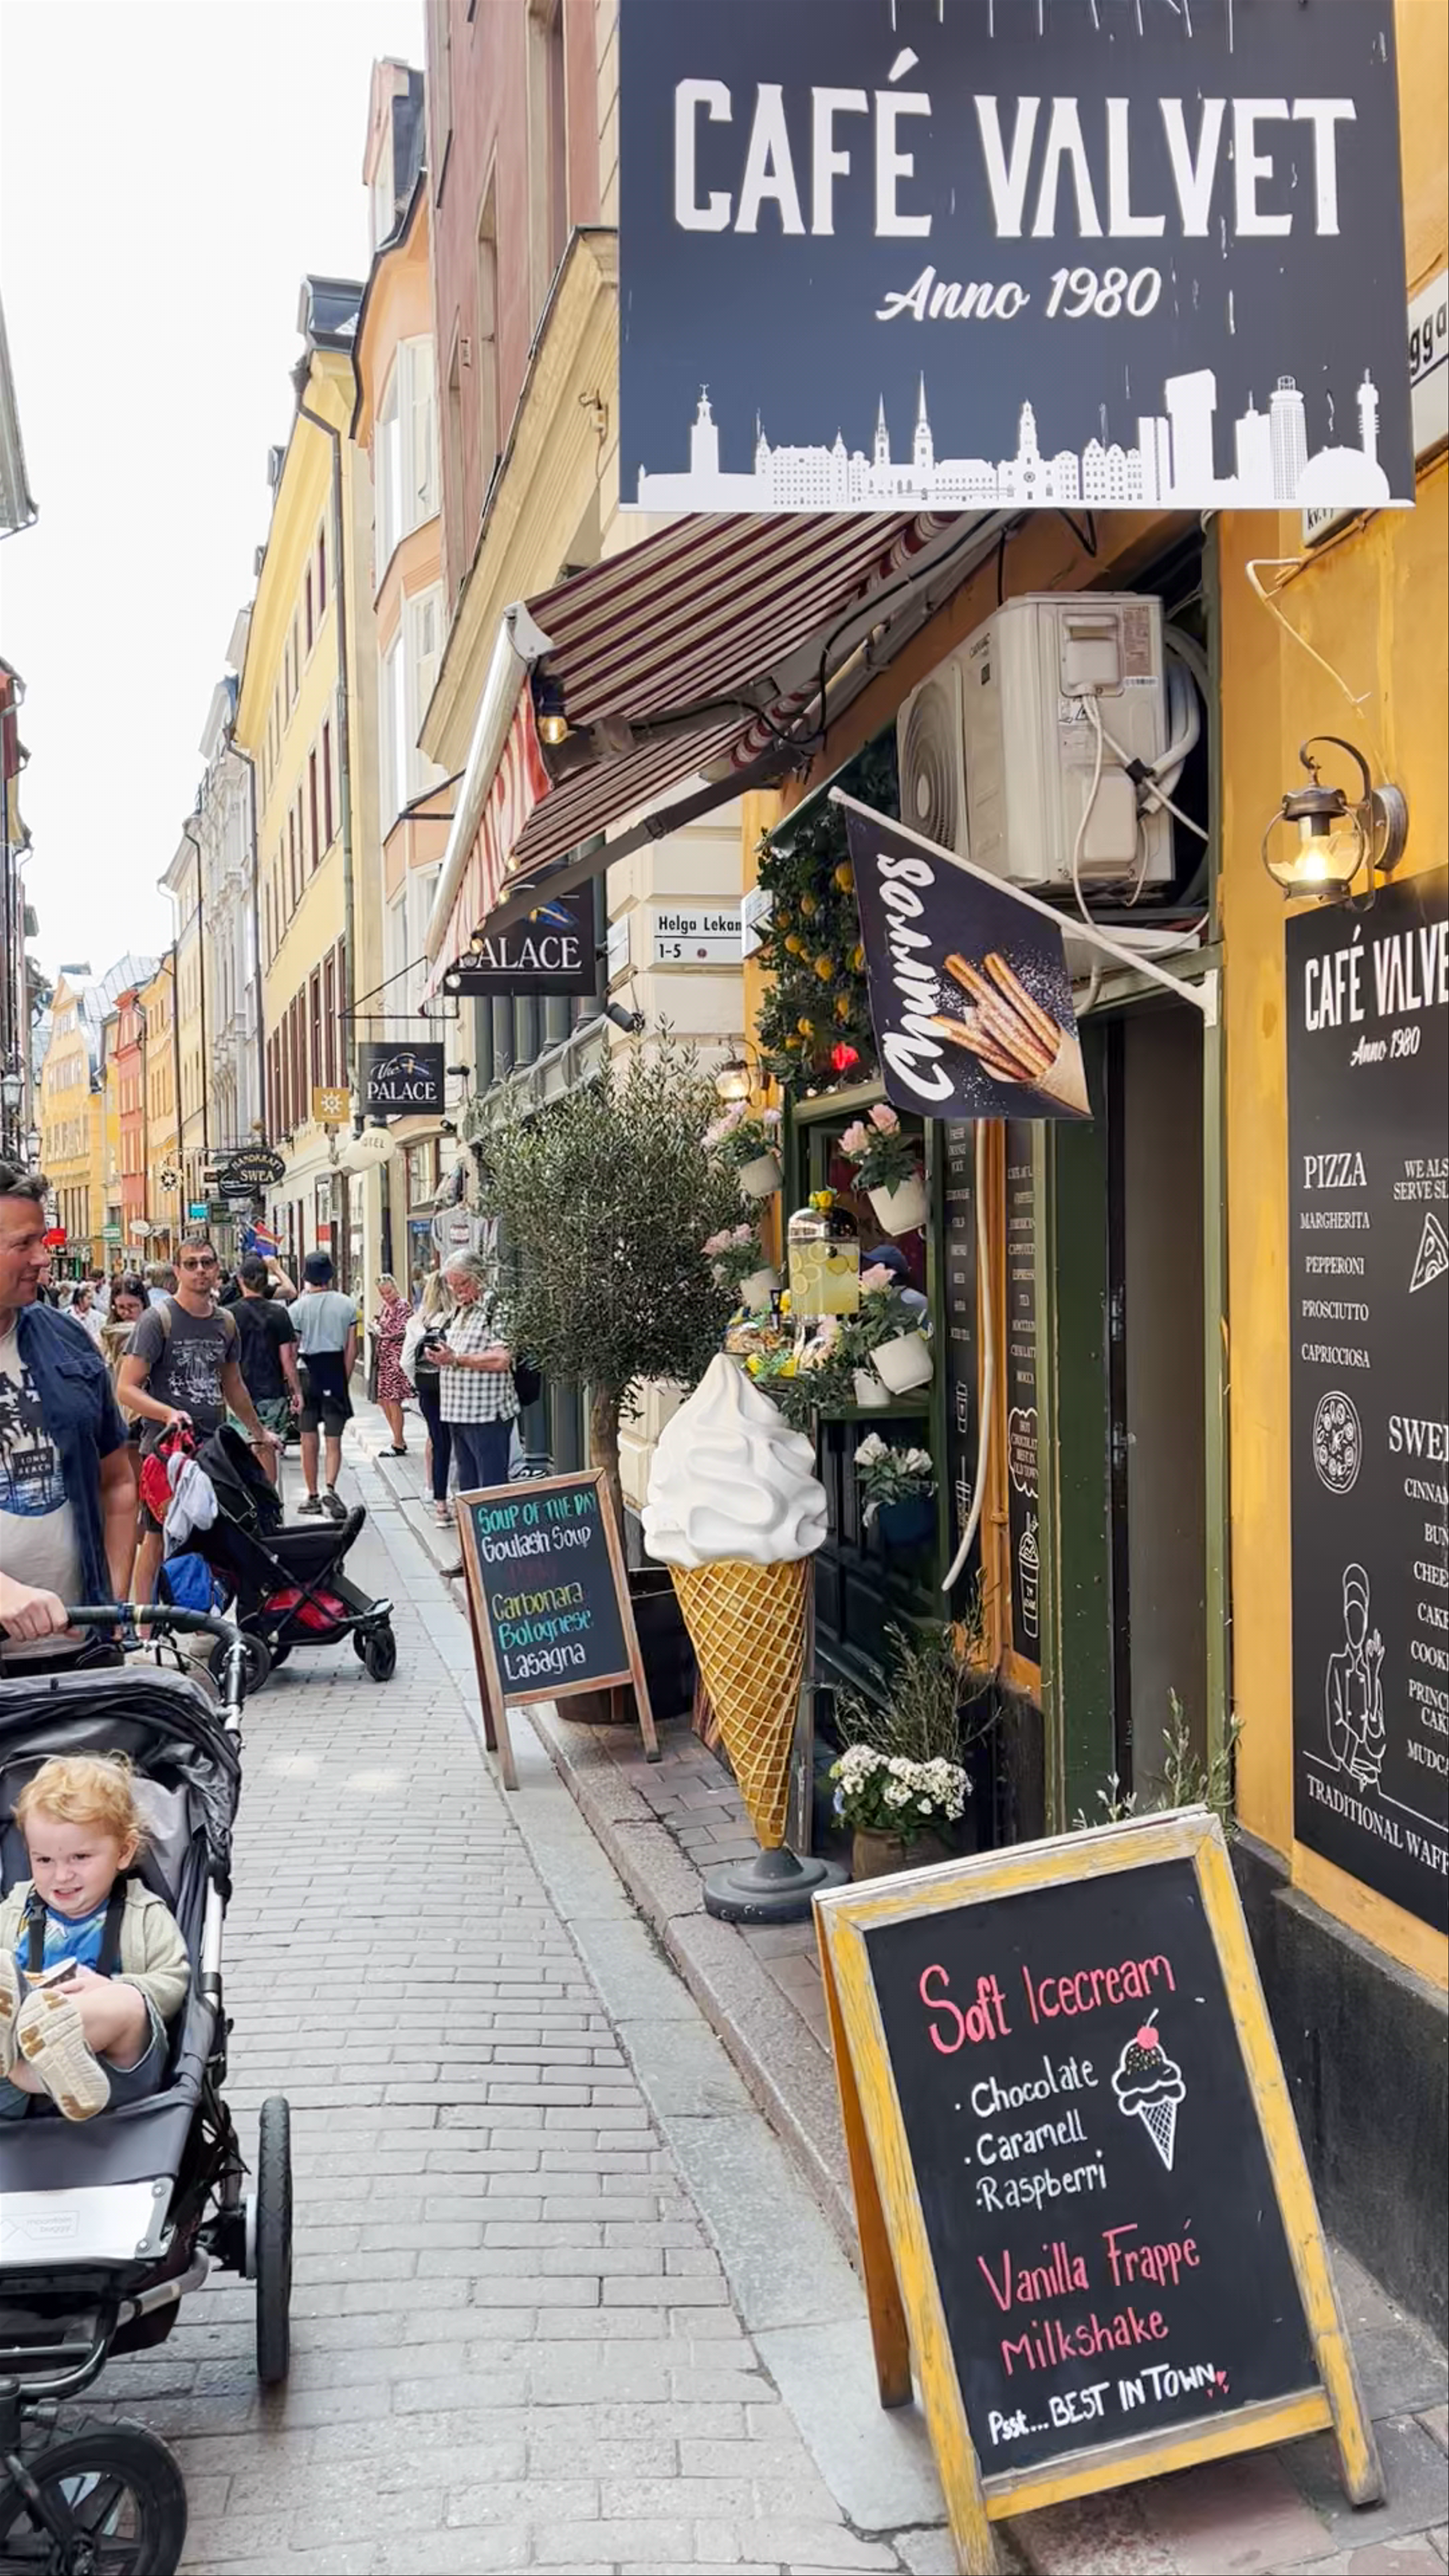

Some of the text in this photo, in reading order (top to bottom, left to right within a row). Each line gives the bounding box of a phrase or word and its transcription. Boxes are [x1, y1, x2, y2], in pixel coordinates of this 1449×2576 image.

[674, 46, 1357, 237] CAFÉ VALVET
[876, 265, 1163, 321] Anno 1980
[658, 915, 697, 934] Helga
[458, 937, 583, 969] ALACE
[659, 943, 681, 958] 1-5
[876, 853, 955, 1102] Churros
[1305, 920, 1449, 1031] CAFÉ VALVE
[1350, 1026, 1421, 1067] Anno 1980
[367, 1081, 437, 1100] PALACE
[240, 1170, 274, 1182] SWEA
[1303, 1152, 1367, 1189] PIZZA
[1404, 1160, 1425, 1178] WE
[1393, 1181, 1433, 1200] SERVE
[1300, 1212, 1371, 1229] MARGHERITA
[1305, 1256, 1365, 1275] PEPPERONI
[1302, 1300, 1369, 1321] PROSCIUTTO
[1301, 1343, 1371, 1368] CAPRICCIOSA
[543, 1496, 574, 1521] THE
[574, 1491, 595, 1516] DAY
[481, 1526, 591, 1563] Goulash Soup
[492, 1582, 583, 1621] Carbonara
[498, 1609, 591, 1650] Bolognese
[503, 1642, 586, 1681] Lasagna
[1307, 1773, 1403, 1849] TRADITIONAL
[919, 1955, 1177, 2054] Soft Icecream
[971, 2055, 1099, 2118] Chocolate
[977, 2108, 1088, 2166] Caramell
[976, 2149, 1108, 2213] Raspberri
[977, 2218, 1200, 2311] Vanilla Frappé
[1001, 2307, 1169, 2376] Milkshake
[1049, 2381, 1110, 2427] BEST
[1118, 2380, 1146, 2411] IN
[1140, 2362, 1217, 2401] TOWN
